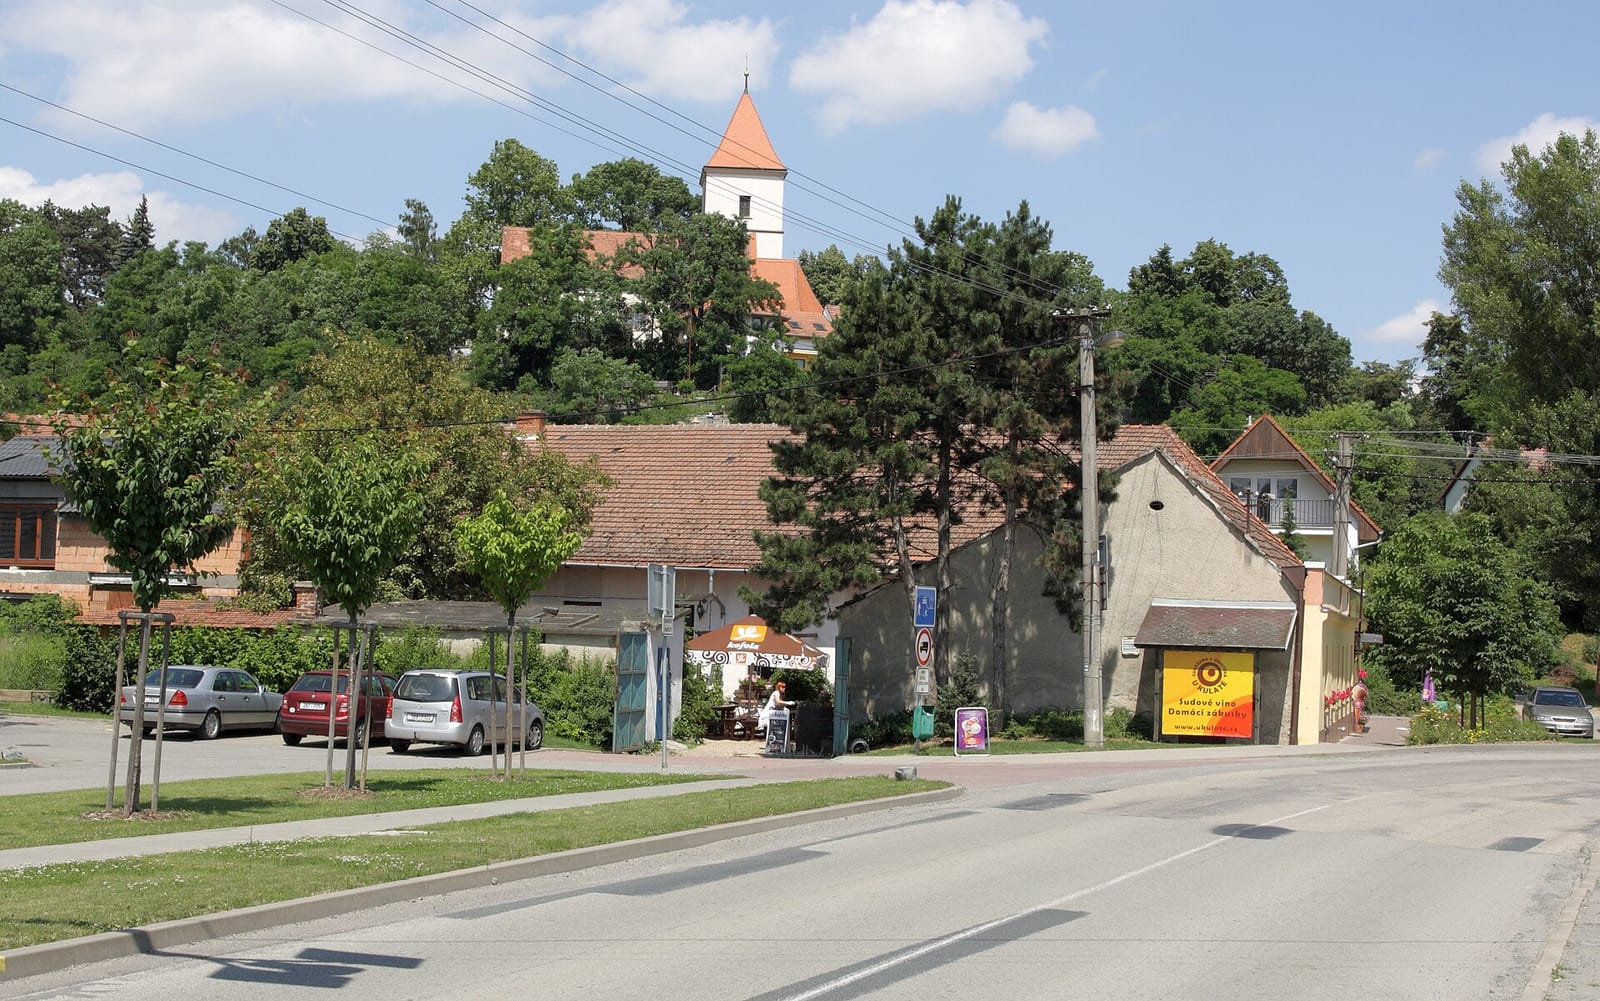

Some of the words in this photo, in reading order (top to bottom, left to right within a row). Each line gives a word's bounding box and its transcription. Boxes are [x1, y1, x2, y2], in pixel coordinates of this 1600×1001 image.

[1179, 698, 1212, 706] Sudové
[1215, 699, 1236, 707] víno
[1168, 708, 1204, 716] Domácí
